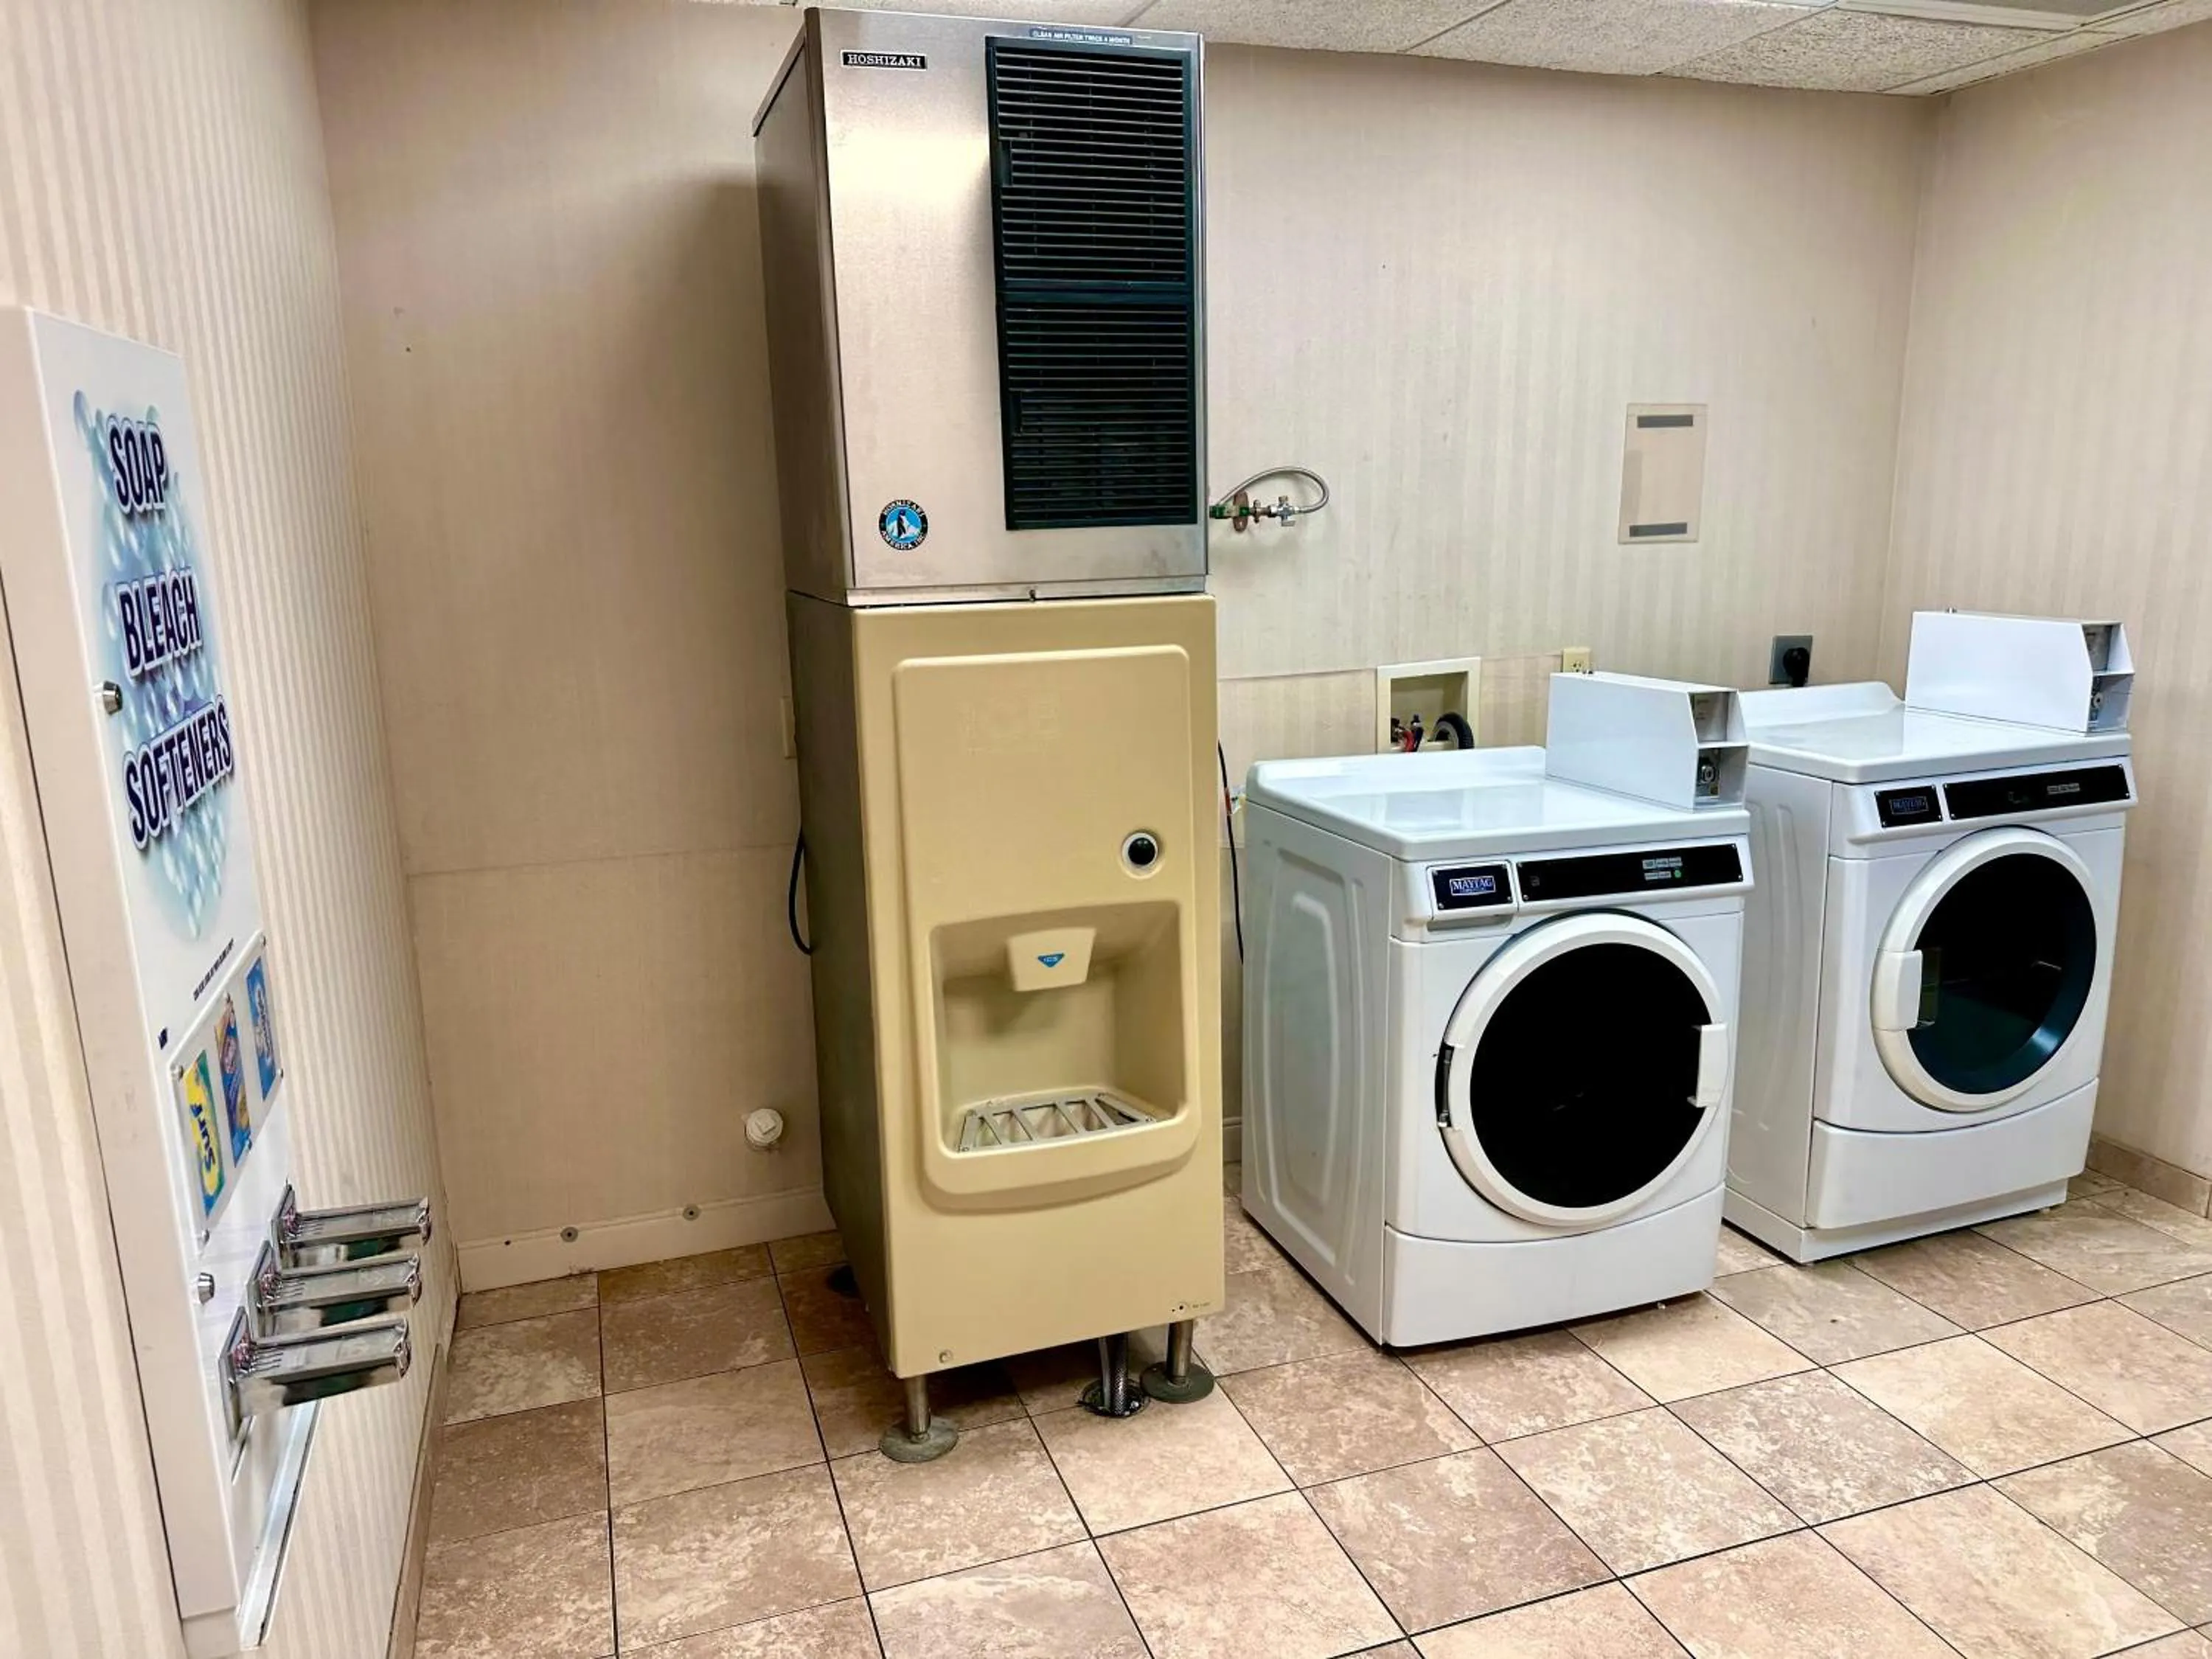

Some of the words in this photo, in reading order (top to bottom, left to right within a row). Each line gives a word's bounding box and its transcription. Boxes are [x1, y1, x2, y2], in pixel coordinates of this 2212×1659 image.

[847, 54, 921, 67] HOSHIZAKI
[109, 422, 166, 510] SOAP
[118, 571, 201, 673] BLEACH
[123, 699, 232, 846] SOFTENERS
[1453, 878, 1492, 890] MAYTAG
